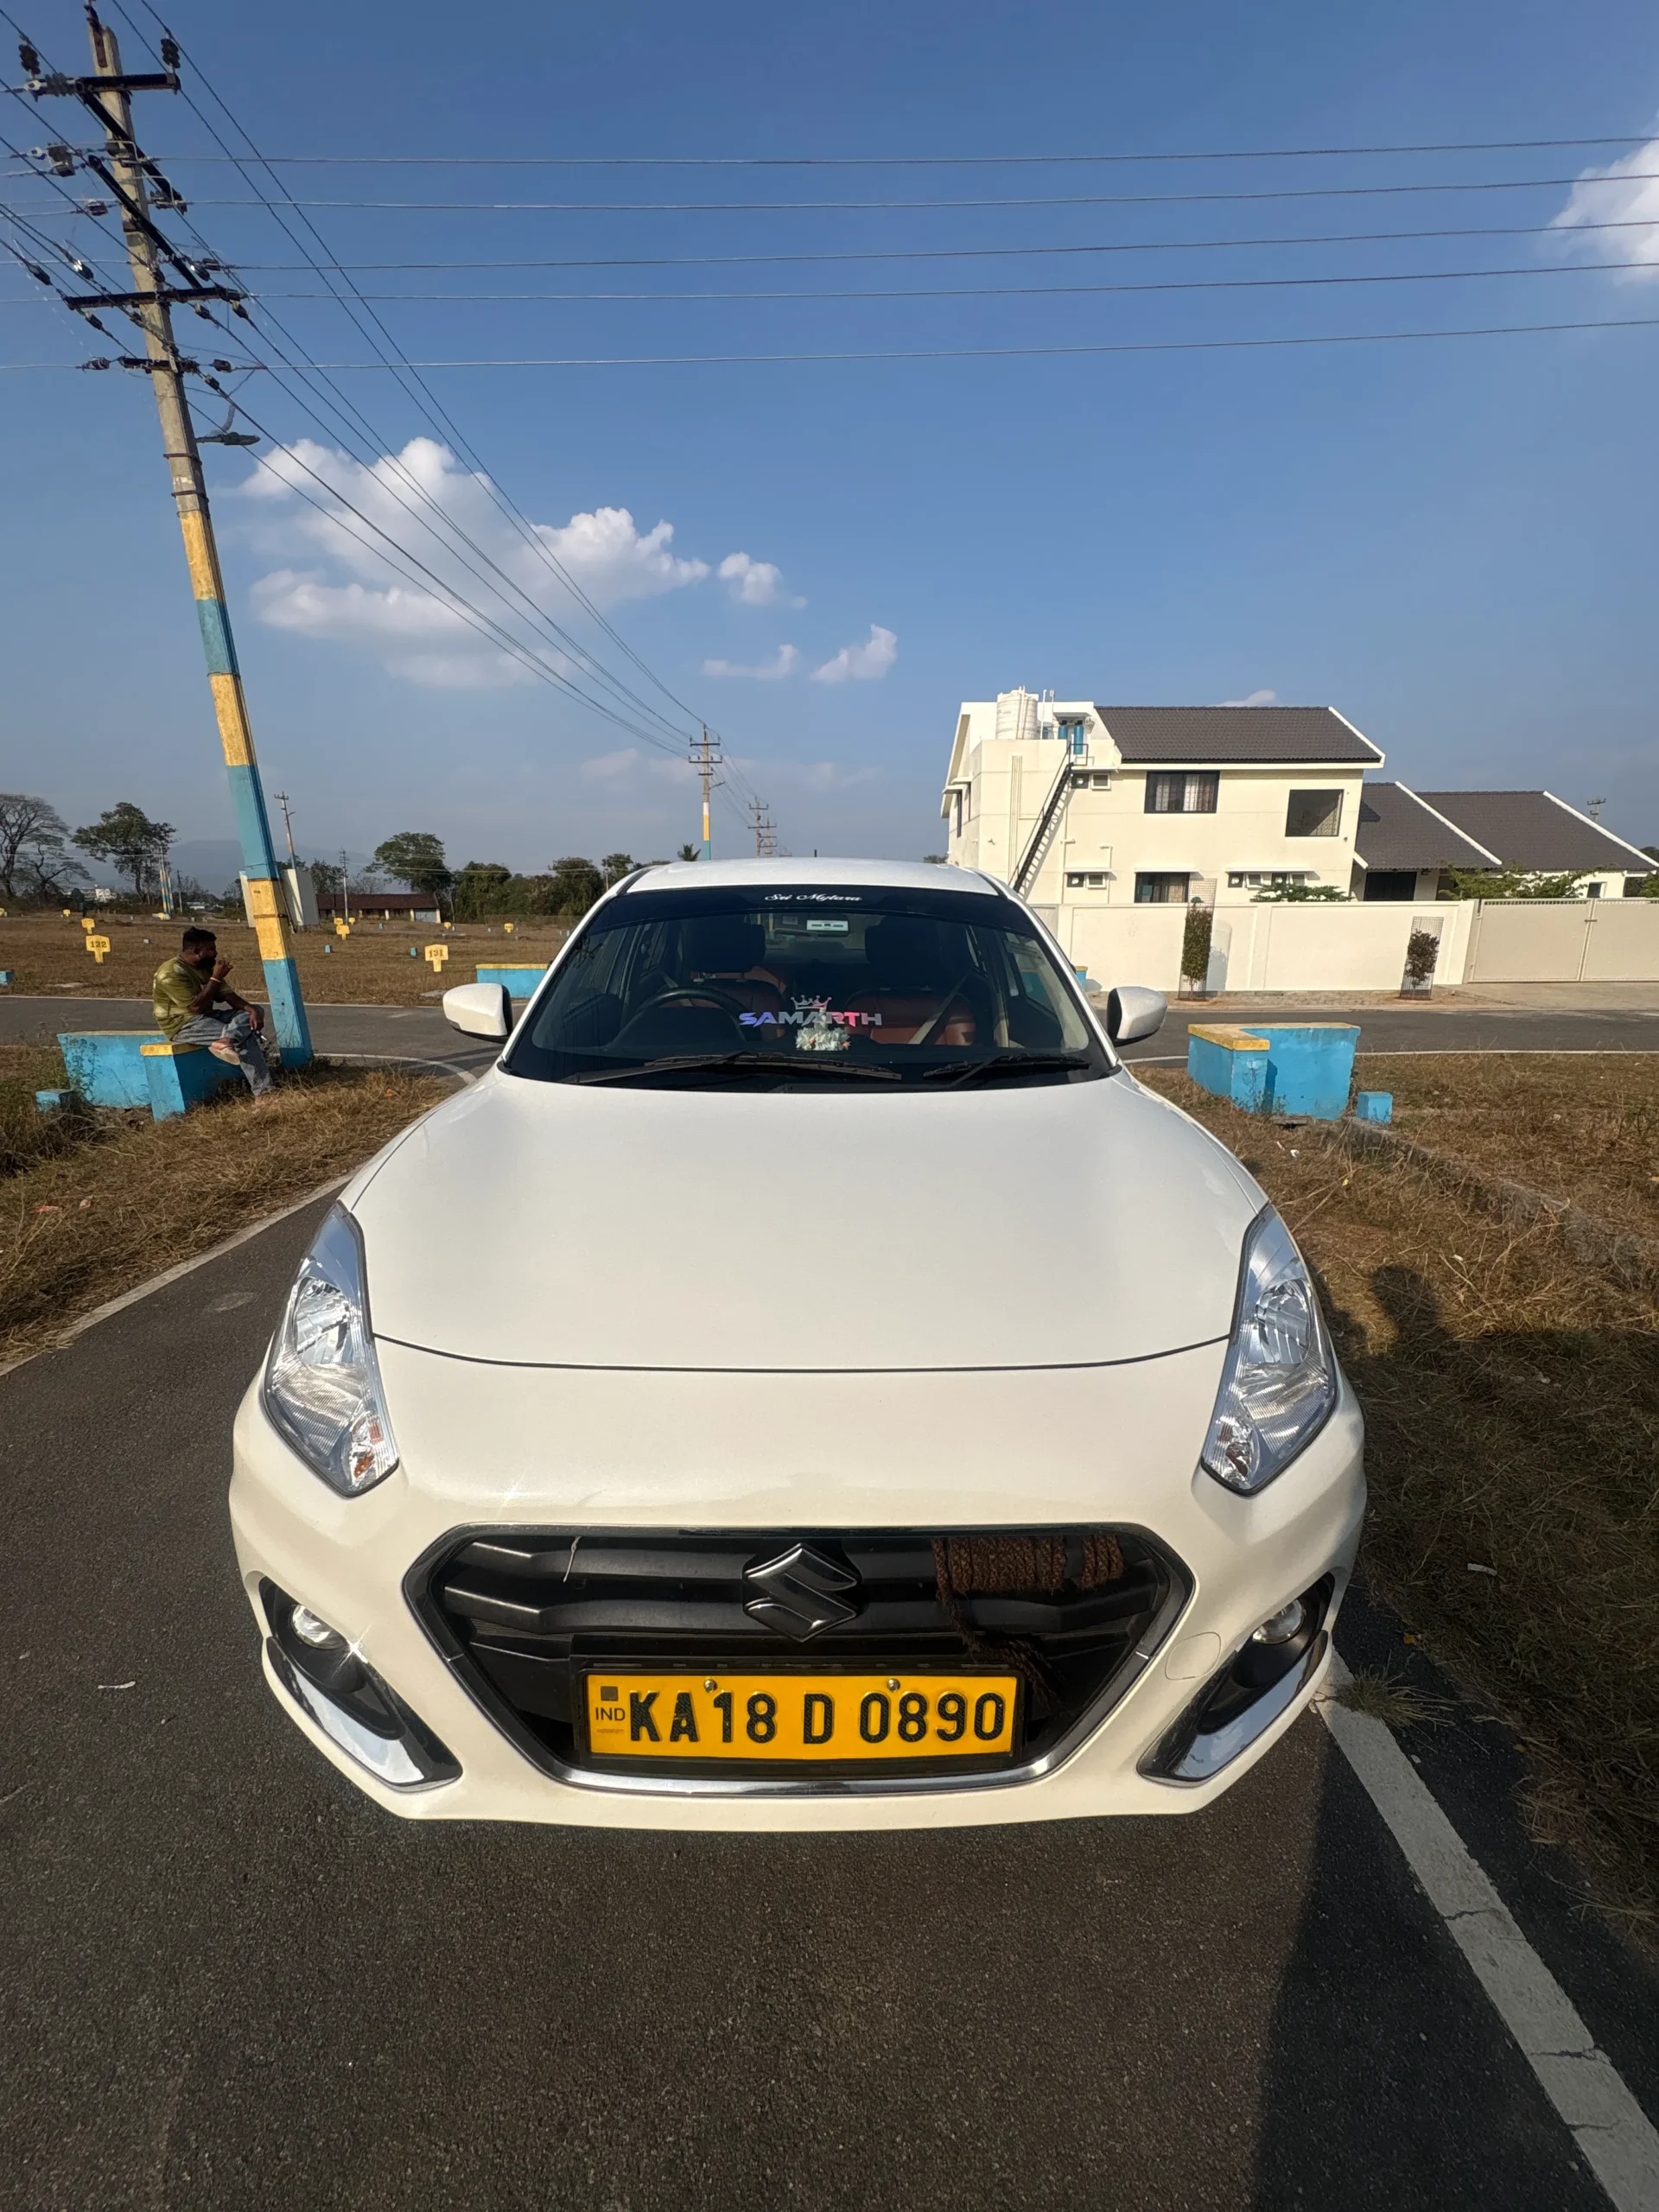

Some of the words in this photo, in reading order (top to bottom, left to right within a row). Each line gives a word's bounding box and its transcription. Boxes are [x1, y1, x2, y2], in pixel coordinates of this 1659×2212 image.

[739, 1011, 882, 1028] SAMARTH
[595, 1707, 626, 1721] IND
[804, 1693, 834, 1744] D
[860, 1692, 1005, 1744] 0890
